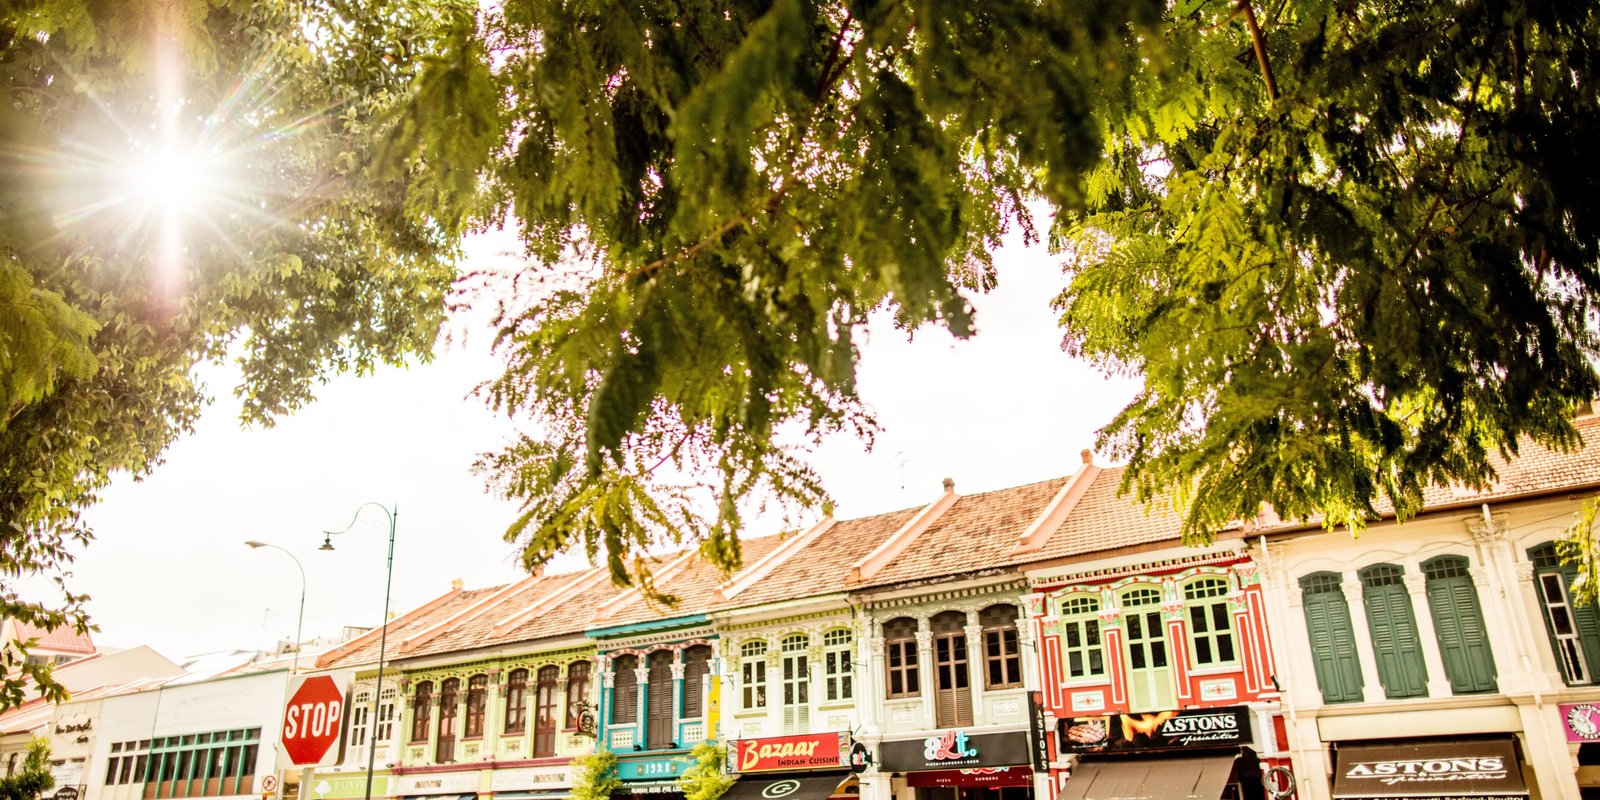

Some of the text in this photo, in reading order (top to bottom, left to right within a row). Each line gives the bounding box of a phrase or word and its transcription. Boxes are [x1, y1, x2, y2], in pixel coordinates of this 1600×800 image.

[285, 701, 340, 739] STOP
[1162, 715, 1237, 733] ASTONS
[1036, 709, 1048, 770] ASTONS
[742, 740, 820, 771] Bazaar
[777, 756, 839, 767] INDIAN CUISINE
[645, 762, 670, 774] 1928
[1346, 758, 1504, 776] ASTONS
